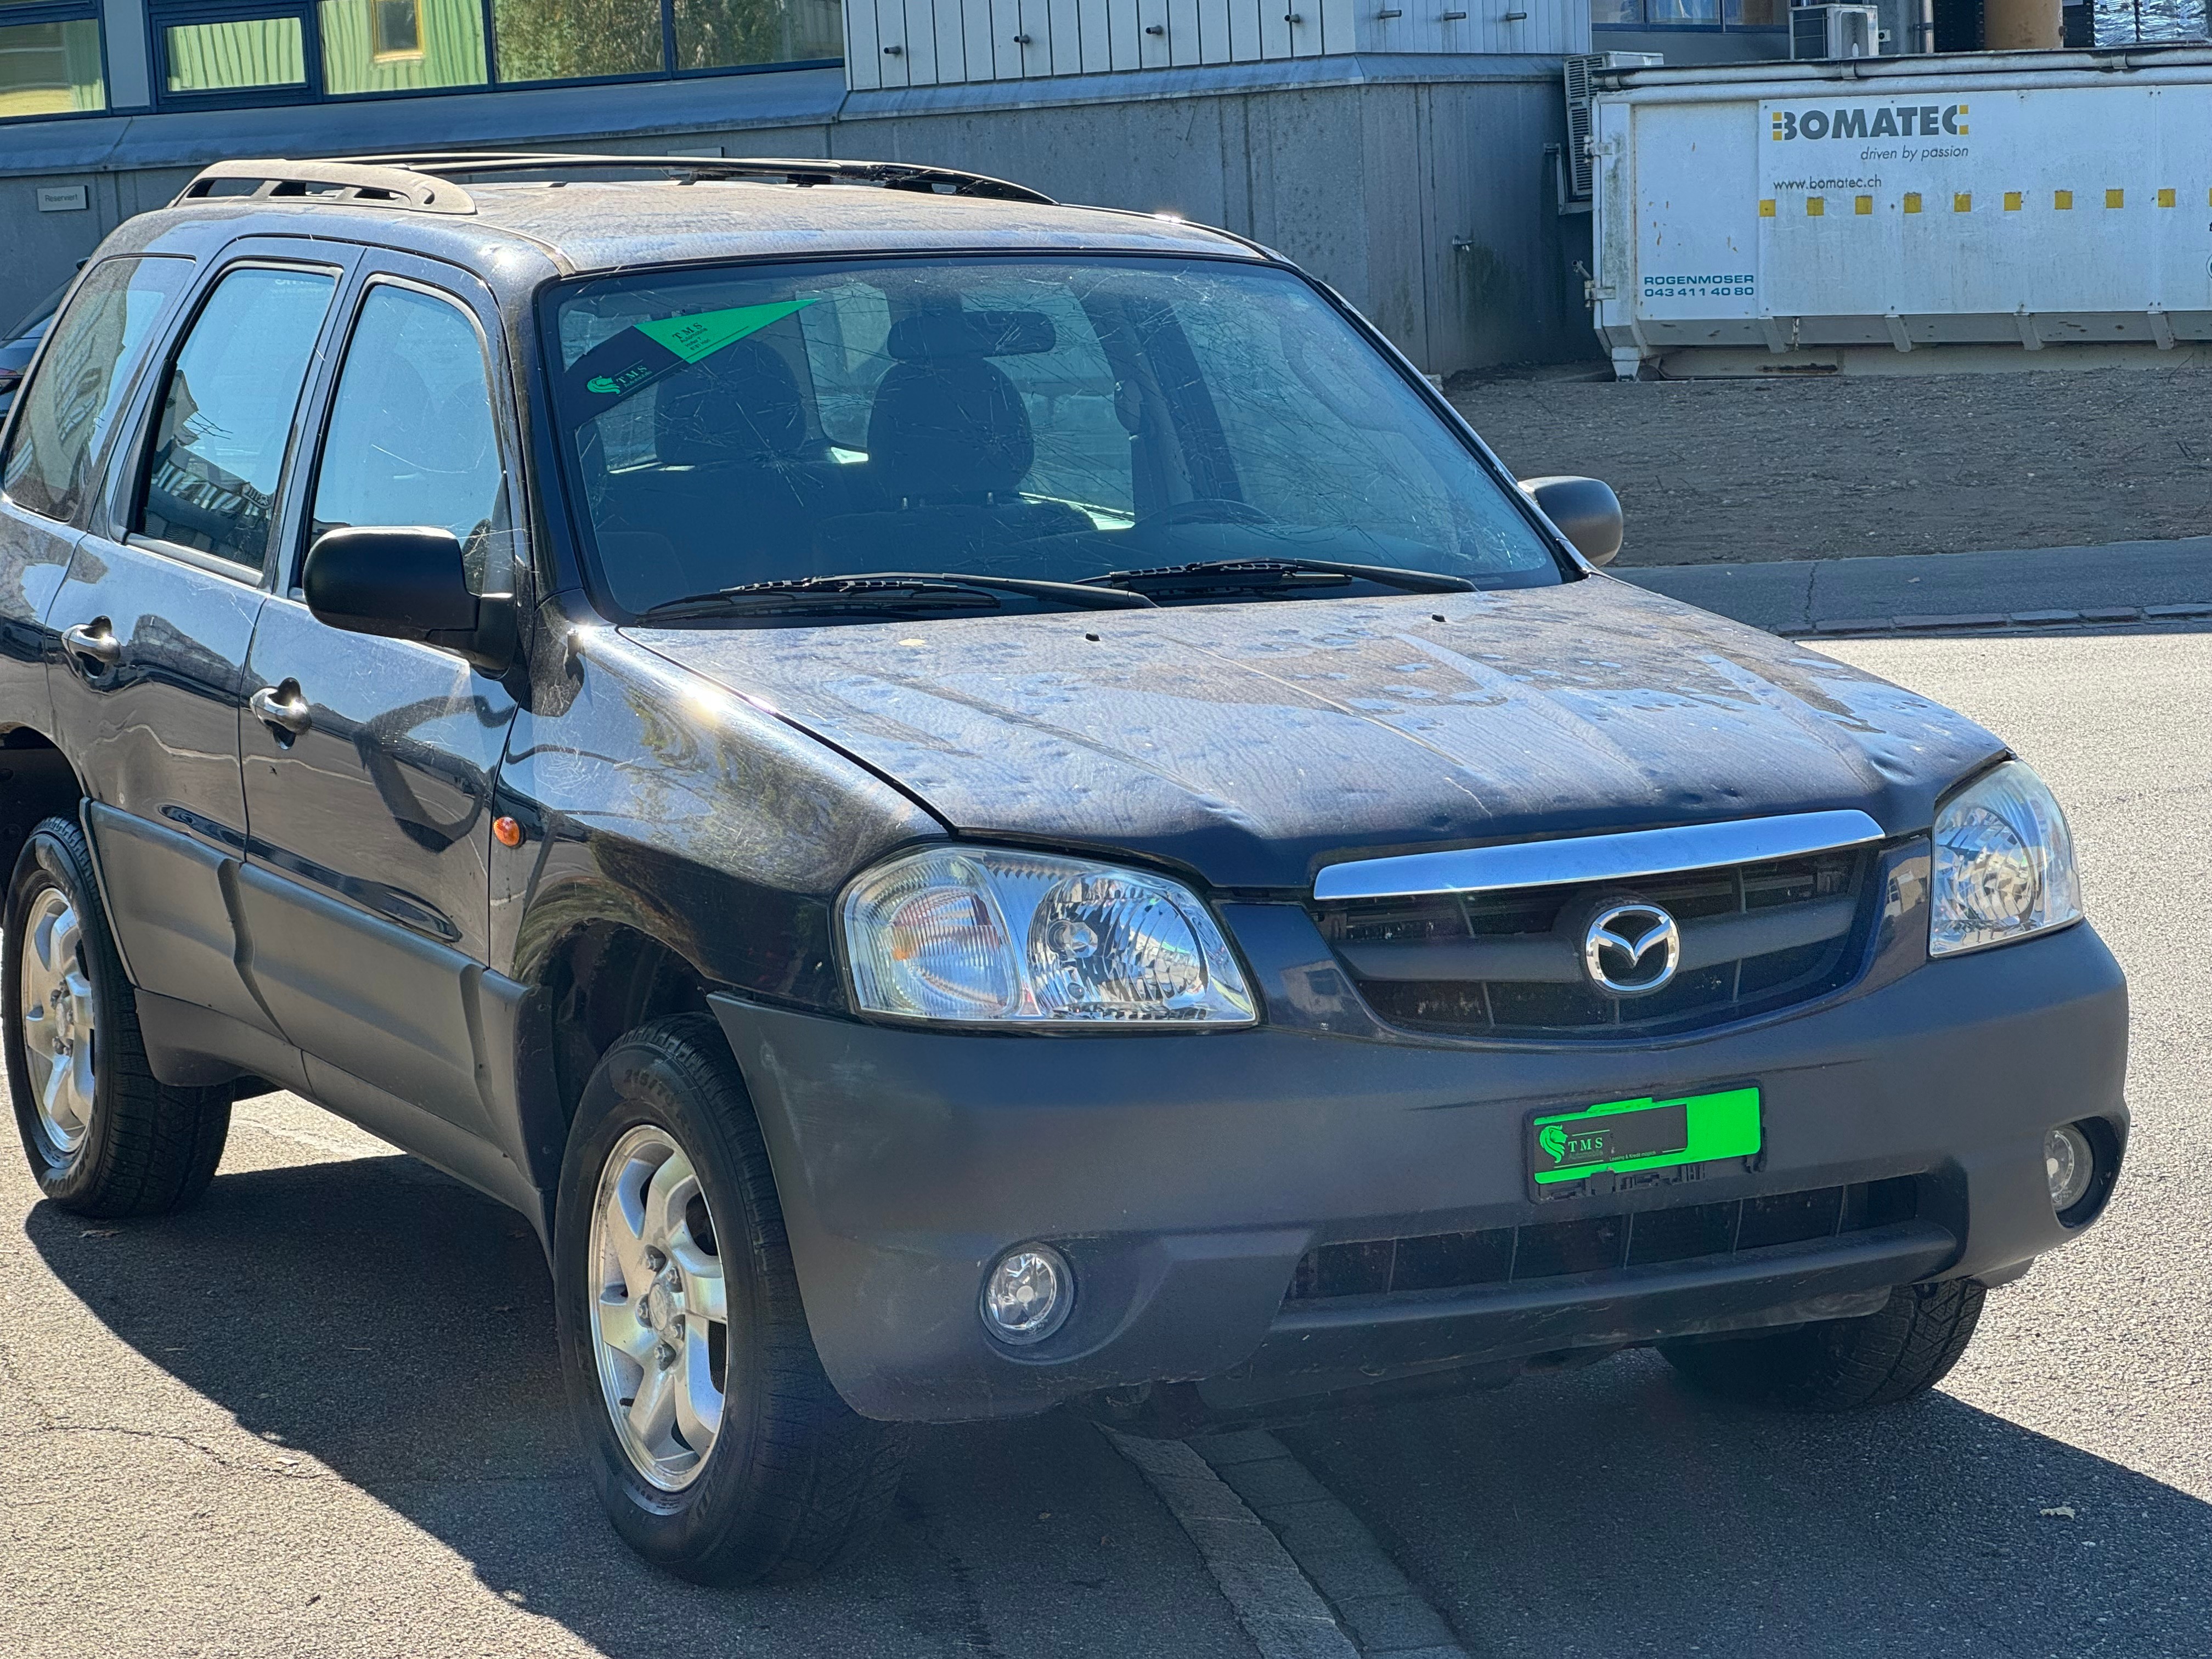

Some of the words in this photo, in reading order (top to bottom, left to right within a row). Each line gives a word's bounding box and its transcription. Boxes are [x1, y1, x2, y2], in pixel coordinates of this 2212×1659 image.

[1773, 105, 1969, 141] BOMATEC
[1860, 146, 1897, 160] driven
[1902, 145, 1917, 162] by
[1921, 145, 1968, 161] passion
[1773, 174, 1882, 190] www.bomatec.ch
[1644, 275, 1754, 285] ROGENMOSER
[1644, 289, 1674, 297] 043
[1678, 288, 1705, 296] 411
[1711, 287, 1730, 296] 40
[1734, 287, 1754, 296] 80
